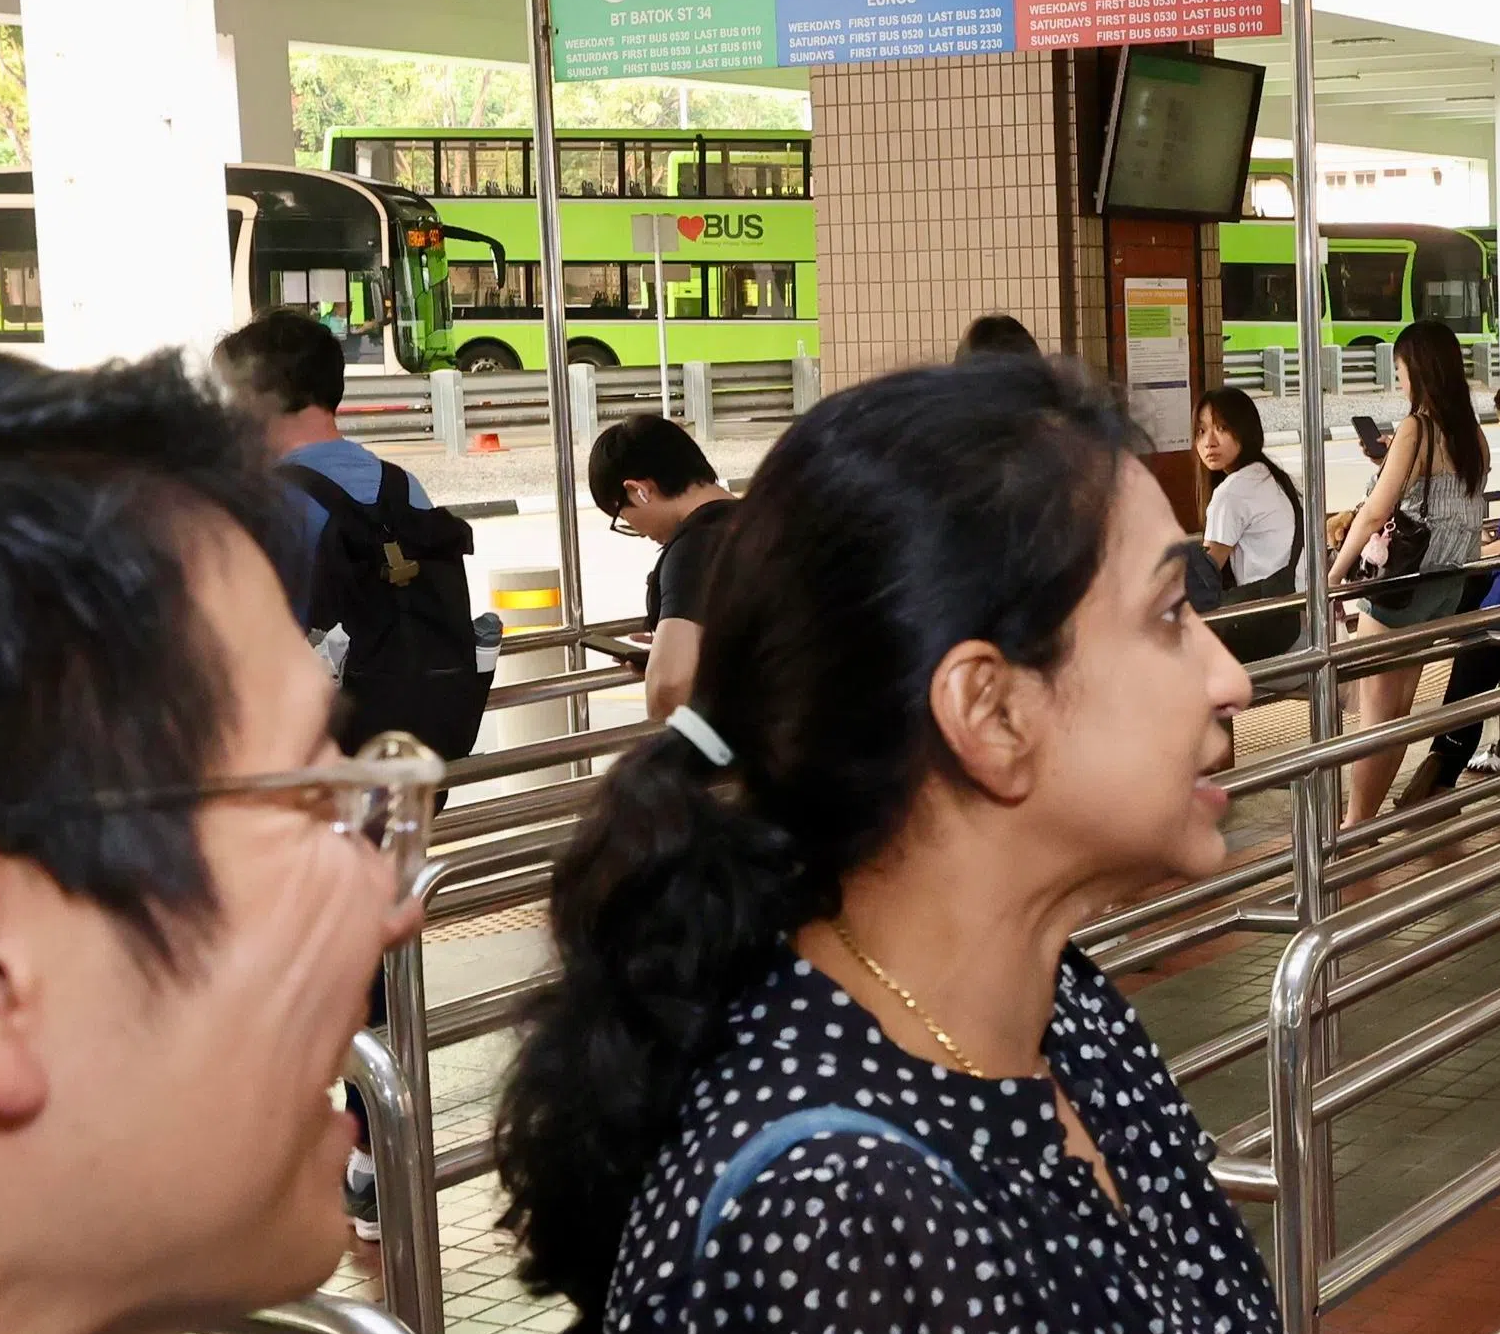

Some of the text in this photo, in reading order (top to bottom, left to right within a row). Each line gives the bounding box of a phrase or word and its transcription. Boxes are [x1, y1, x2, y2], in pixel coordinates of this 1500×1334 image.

[611, 7, 711, 26] BT BATOK ST 34
[1030, 1, 1087, 15] WEEKDAYS
[1096, 0, 1124, 10] FIRST
[1030, 5, 1262, 31] SATURDAYS FIRST BUS 0530 LAST BUS 0110
[789, 8, 1001, 32] WEEKDAYS FIRST BUS 0520 LAST BUS 2330
[565, 26, 761, 49] WEEKDAYS FIRST BUS 0530 LAST BUS 0110
[789, 24, 1002, 48] SATURDAYS FIRST BUS 0520 LAST BUS 2330
[1031, 21, 1262, 46] SUNDAYS FIRST BUS 0530 LAST BUS 0110
[566, 41, 761, 63] SATURDAYS FIRST BUS 0530 LAST BUS 0110
[790, 39, 1002, 62] SUNDAYS FIRST BUS 0520 LAST BUS 2330
[704, 214, 763, 239] BUS
